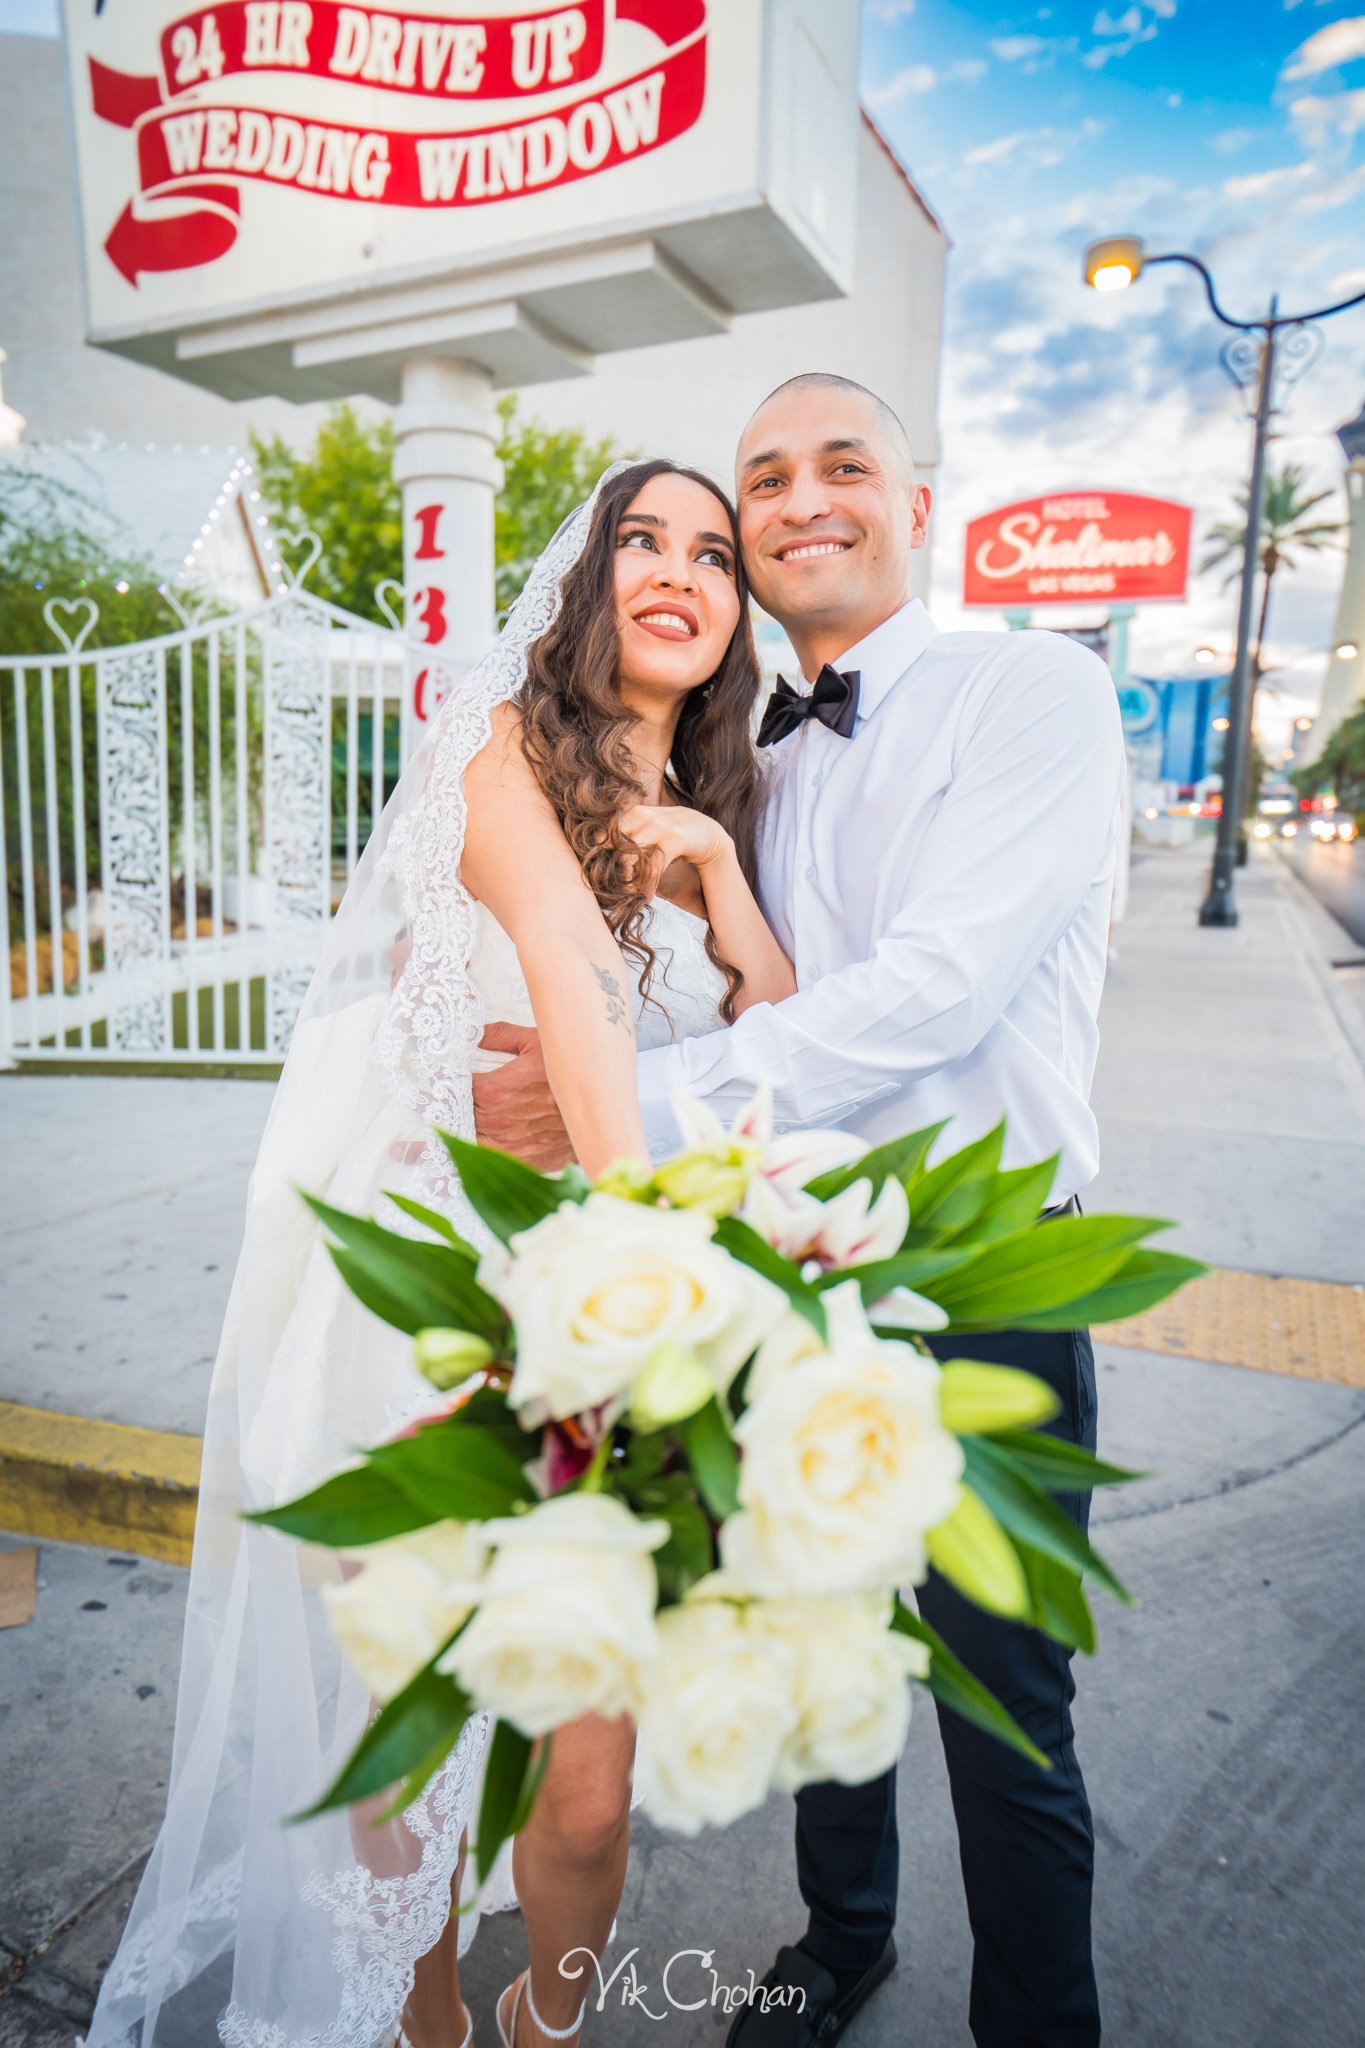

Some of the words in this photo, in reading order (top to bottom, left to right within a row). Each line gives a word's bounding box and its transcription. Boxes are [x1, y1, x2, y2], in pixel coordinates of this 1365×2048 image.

[171, 12, 224, 84] 24
[243, 2, 313, 67] HR
[329, 8, 486, 92] DRIVE
[511, 8, 587, 89] UP
[160, 106, 391, 199] WEDDING
[416, 71, 665, 201] WINDOW
